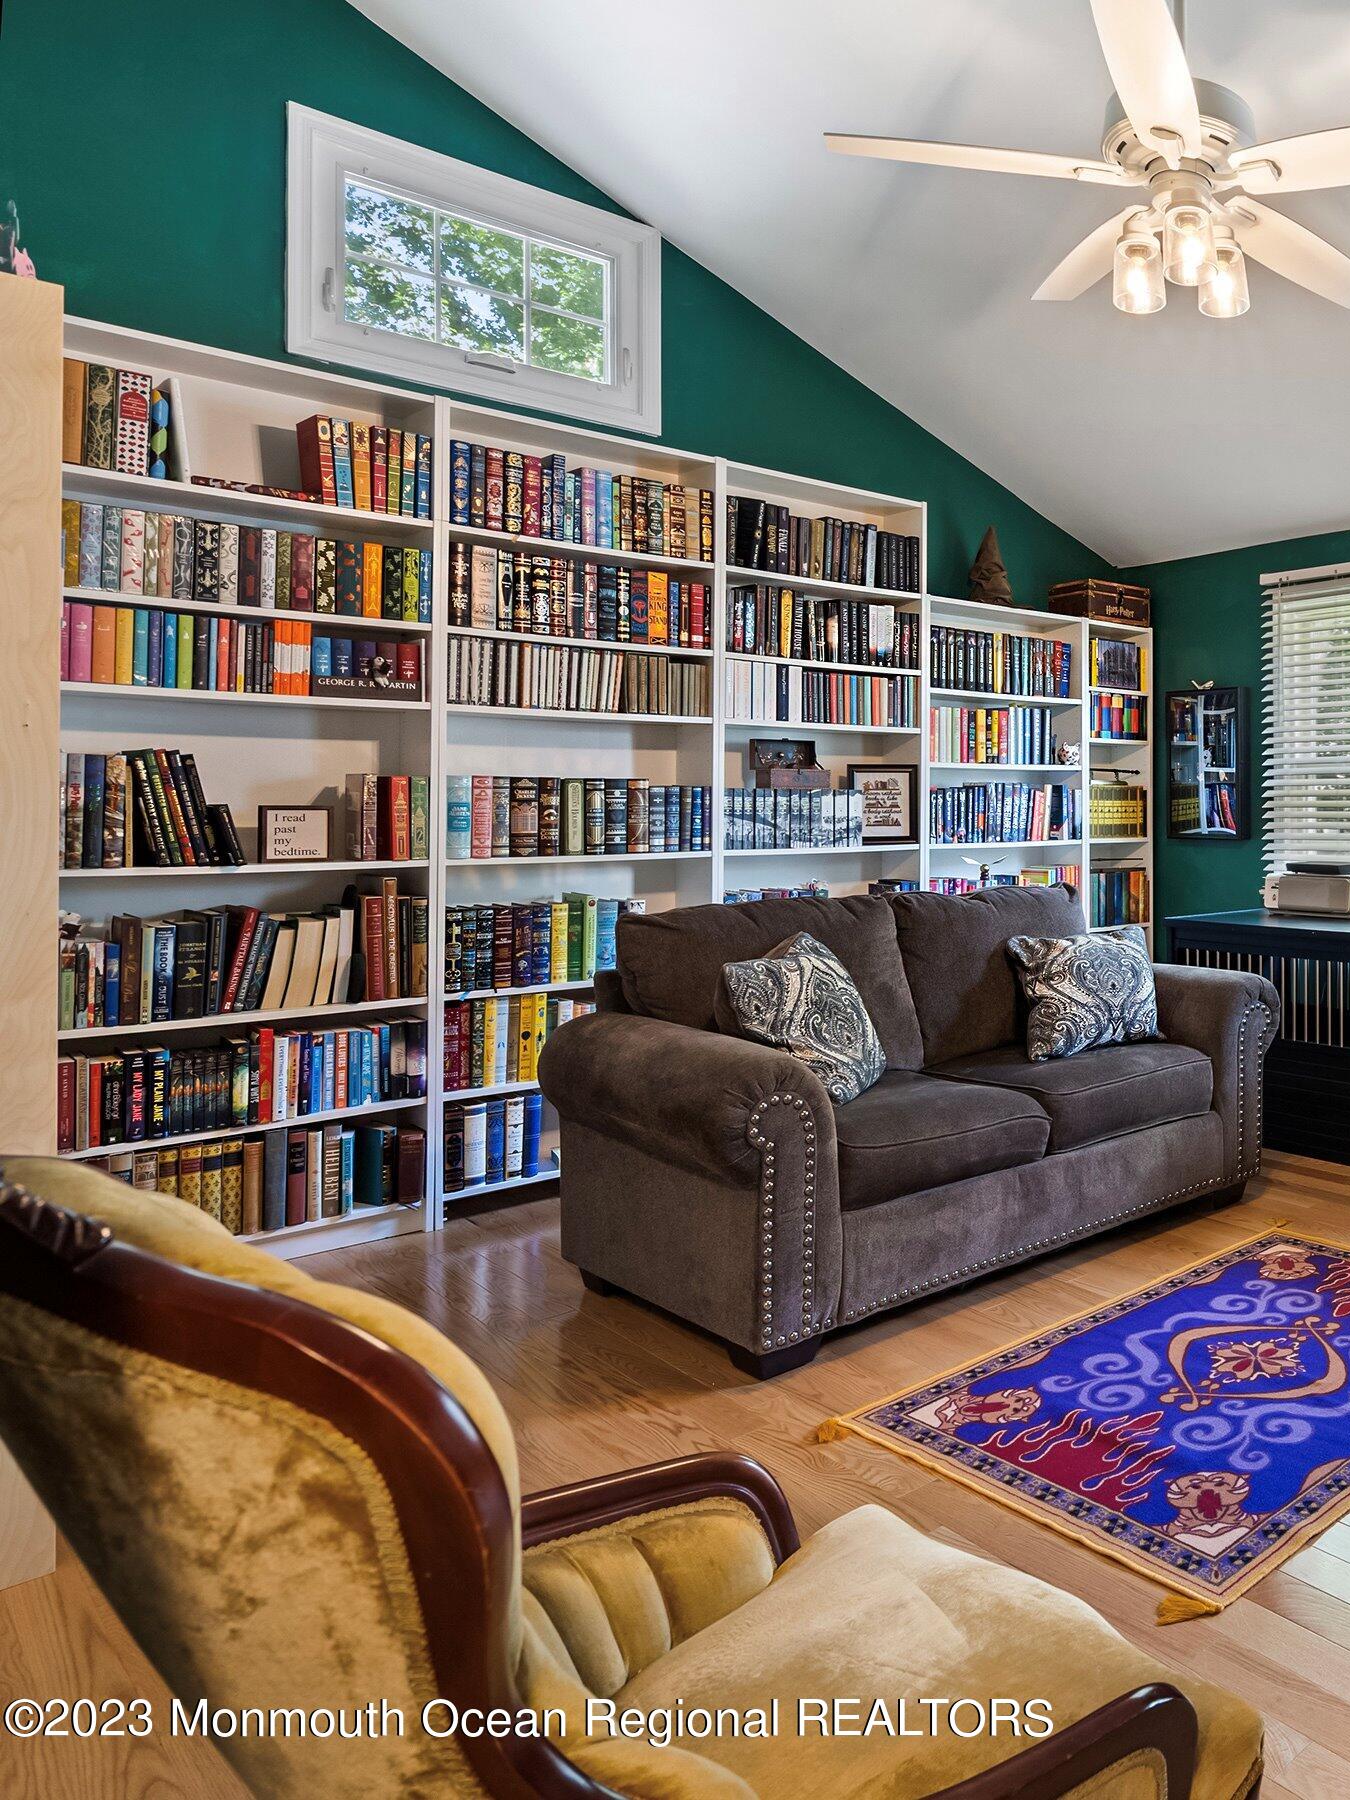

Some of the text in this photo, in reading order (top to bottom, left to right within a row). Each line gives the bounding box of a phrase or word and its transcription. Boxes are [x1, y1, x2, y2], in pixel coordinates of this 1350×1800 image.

[778, 528, 789, 554] FINALE
[649, 601, 667, 610] KING
[649, 617, 667, 625] STAND
[794, 606, 803, 650] NINTH HOUSE
[318, 678, 356, 687] GEORGE
[144, 787, 156, 817] HISTORY
[154, 827, 165, 850] MAGIC
[282, 813, 306, 822] read
[274, 825, 296, 836] past
[274, 838, 292, 846] my
[274, 847, 321, 857] bedtime.
[160, 938, 169, 951] THE
[160, 952, 170, 974] BOOK
[228, 932, 251, 993] FAIRYTALE BAKING
[248, 946, 258, 964] MAGIC
[243, 964, 254, 979] WITH
[158, 986, 167, 1005] DUST
[338, 1034, 347, 1048] BOOK
[338, 1048, 347, 1067] LOVERS
[132, 1072, 142, 1122] MY LADY JANE
[153, 1070, 164, 1122] MY PLAIN JANE
[324, 1150, 340, 1201] HELL BENT
